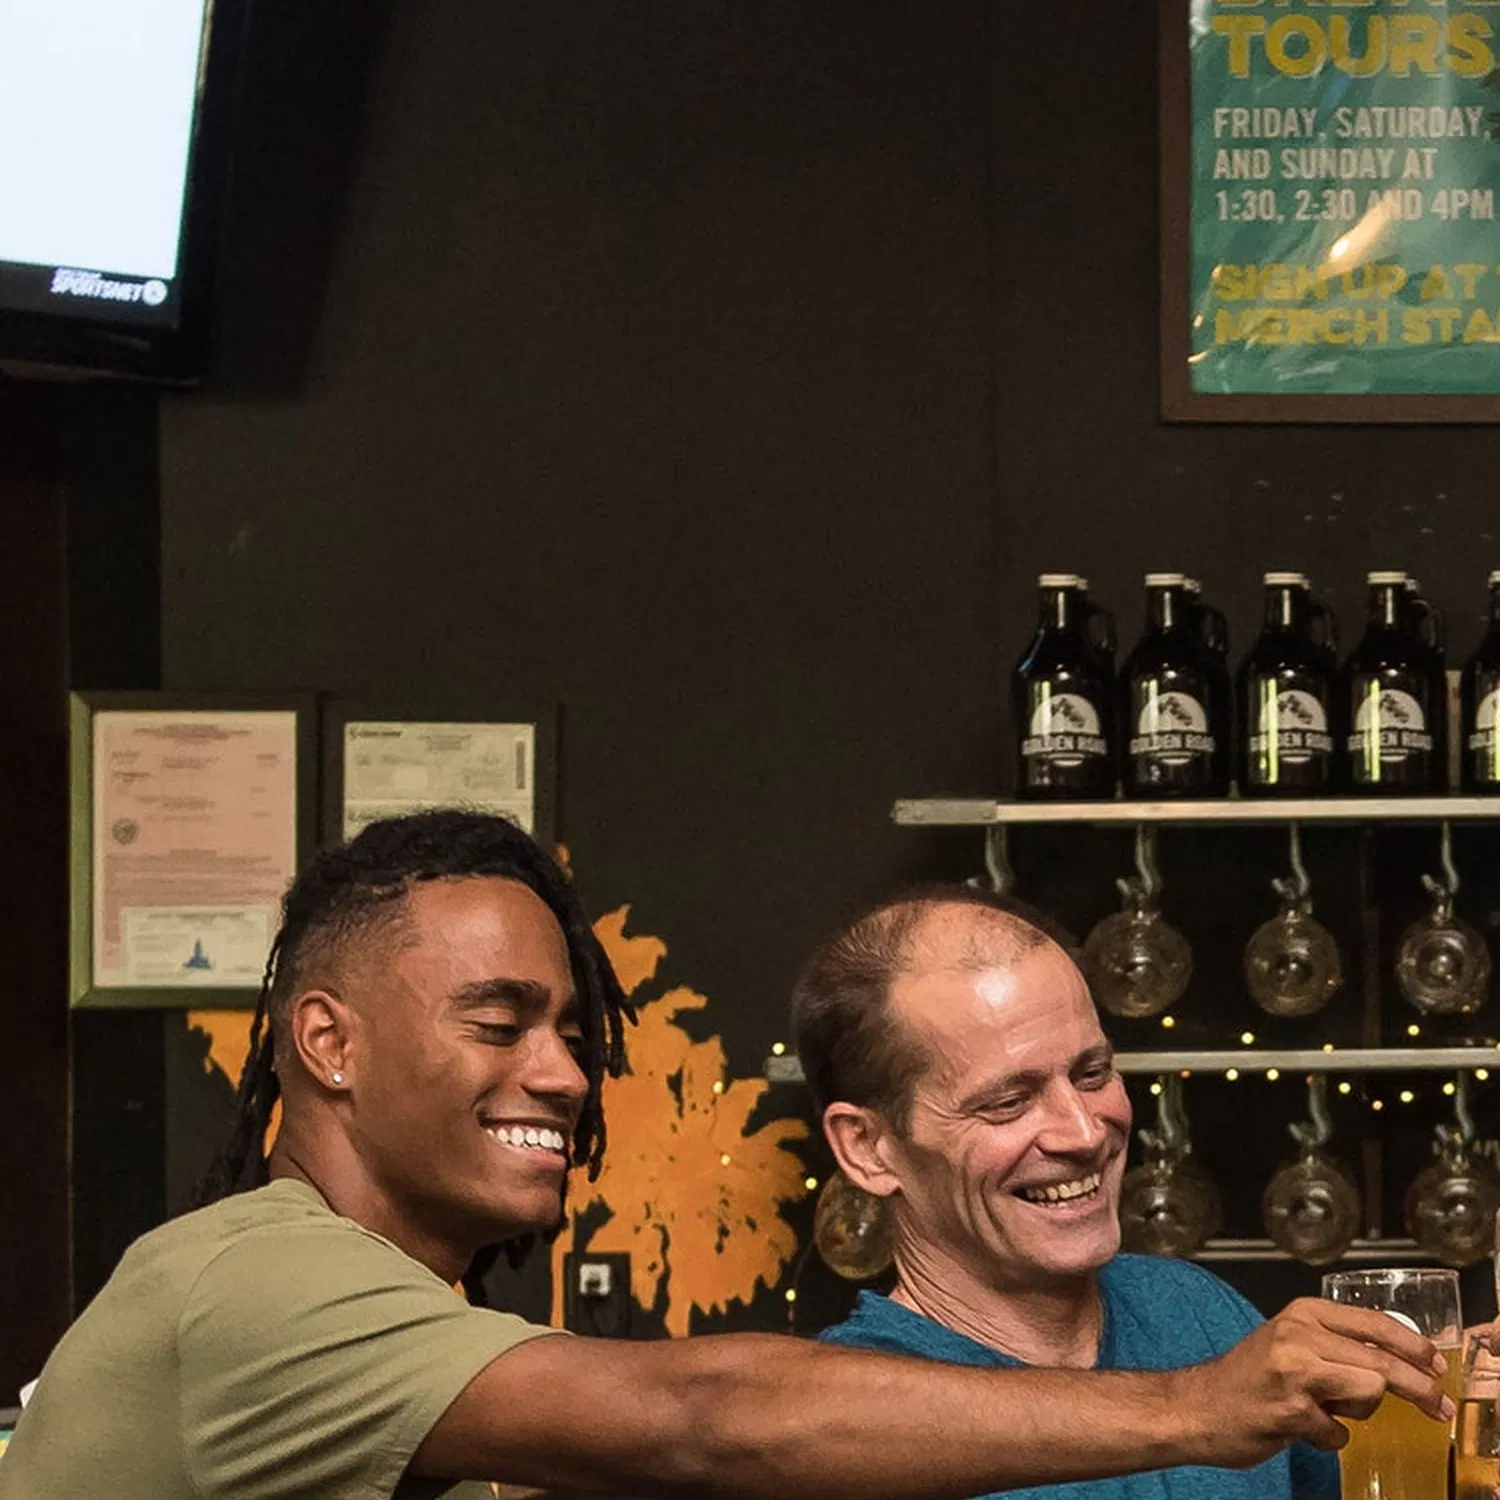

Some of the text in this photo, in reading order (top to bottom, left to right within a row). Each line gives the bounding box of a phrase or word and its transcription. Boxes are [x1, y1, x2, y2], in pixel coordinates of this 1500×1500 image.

[1211, 12, 1497, 79] TOURS
[1335, 106, 1492, 141] SATURDAY,
[1213, 147, 1438, 180] AND SUNDAY AT
[1215, 188, 1494, 223] 1:30, 2:30 AND 4PM
[1215, 263, 1332, 301] SIGN
[1341, 263, 1407, 301] UP
[1421, 263, 1488, 301] AT
[1214, 307, 1389, 345] MERCH
